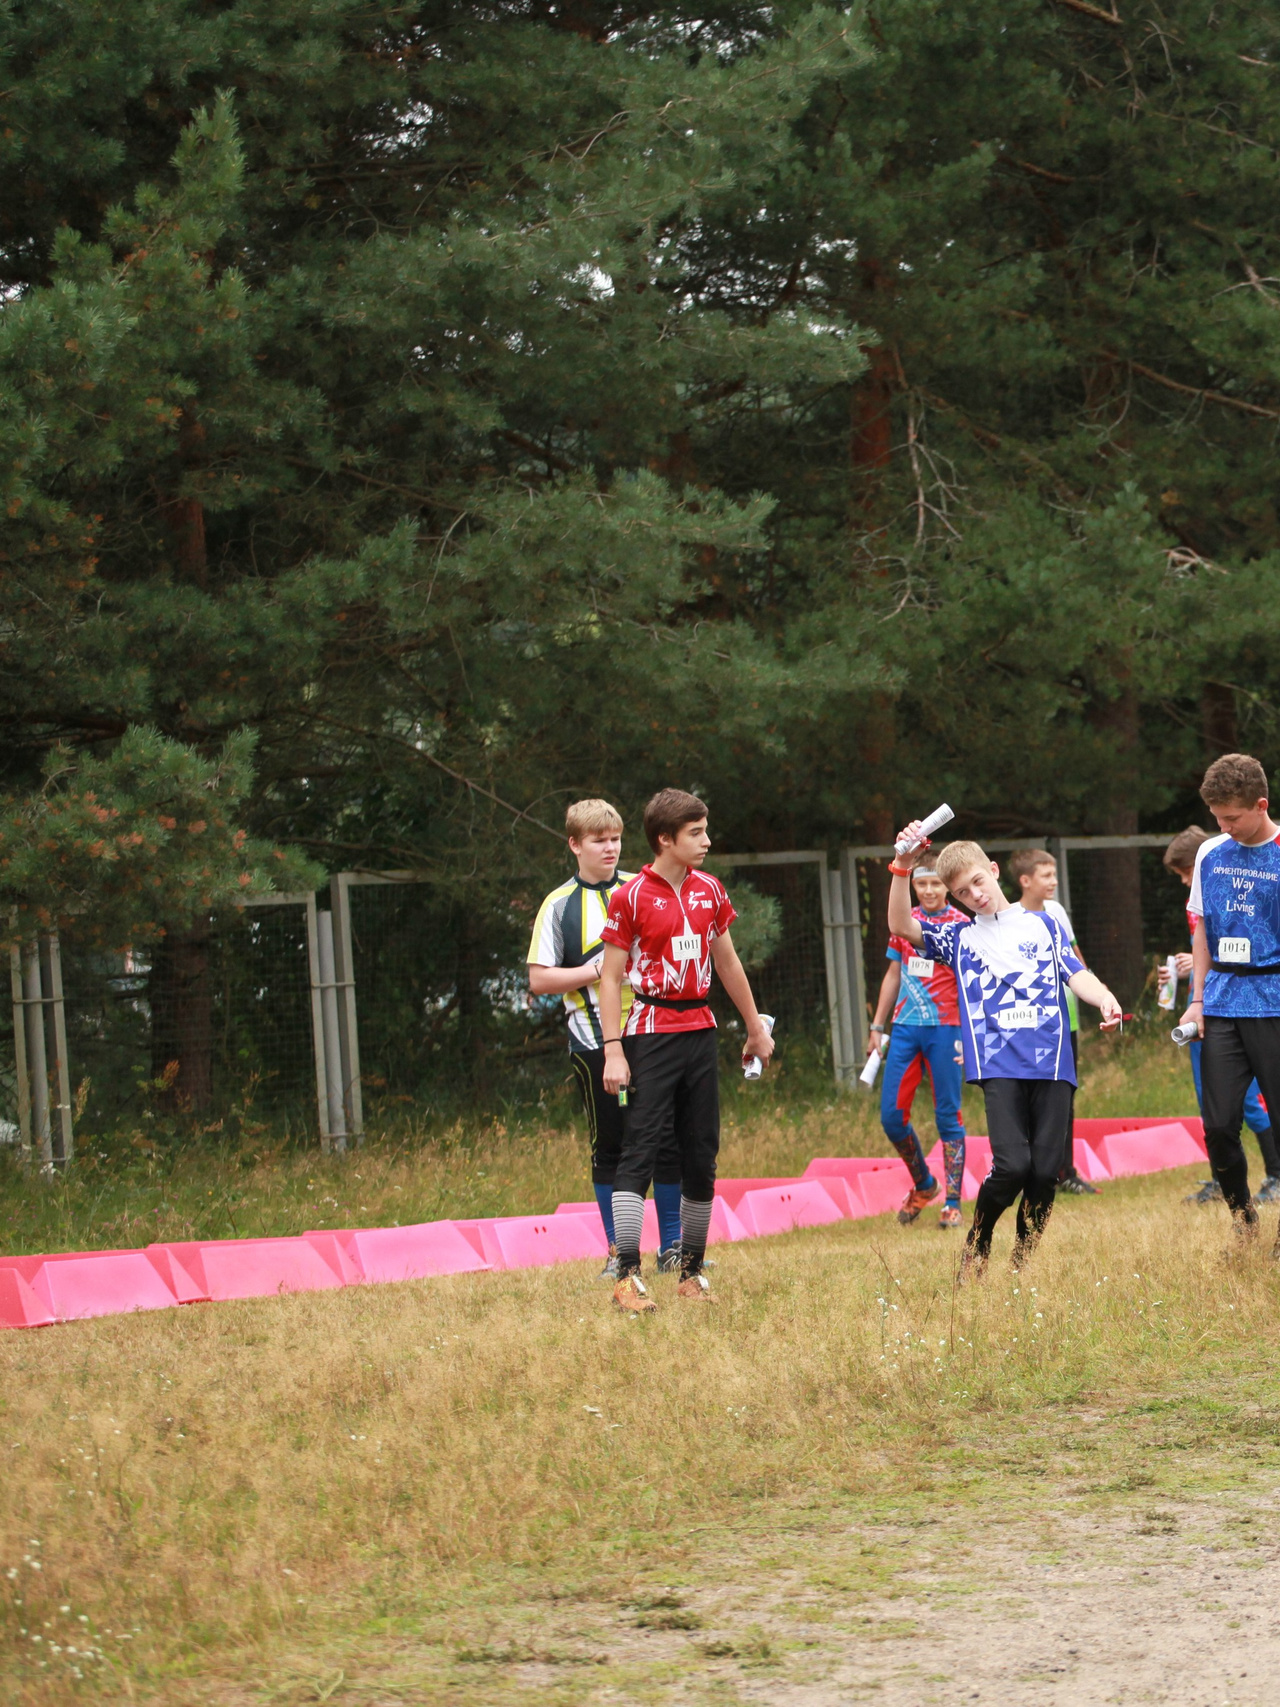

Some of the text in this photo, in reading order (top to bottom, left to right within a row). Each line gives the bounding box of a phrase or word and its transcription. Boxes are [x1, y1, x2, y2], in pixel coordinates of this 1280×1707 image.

[1213, 866, 1279, 882] ОРИЕНТИРОВАНИЕ
[1232, 877, 1255, 892] Way
[1237, 891, 1247, 901] of
[1226, 900, 1255, 917] Living
[678, 939, 699, 951] 1011
[1223, 942, 1246, 953] 1014
[910, 960, 931, 969] 1078
[1006, 1010, 1033, 1021] 1004
